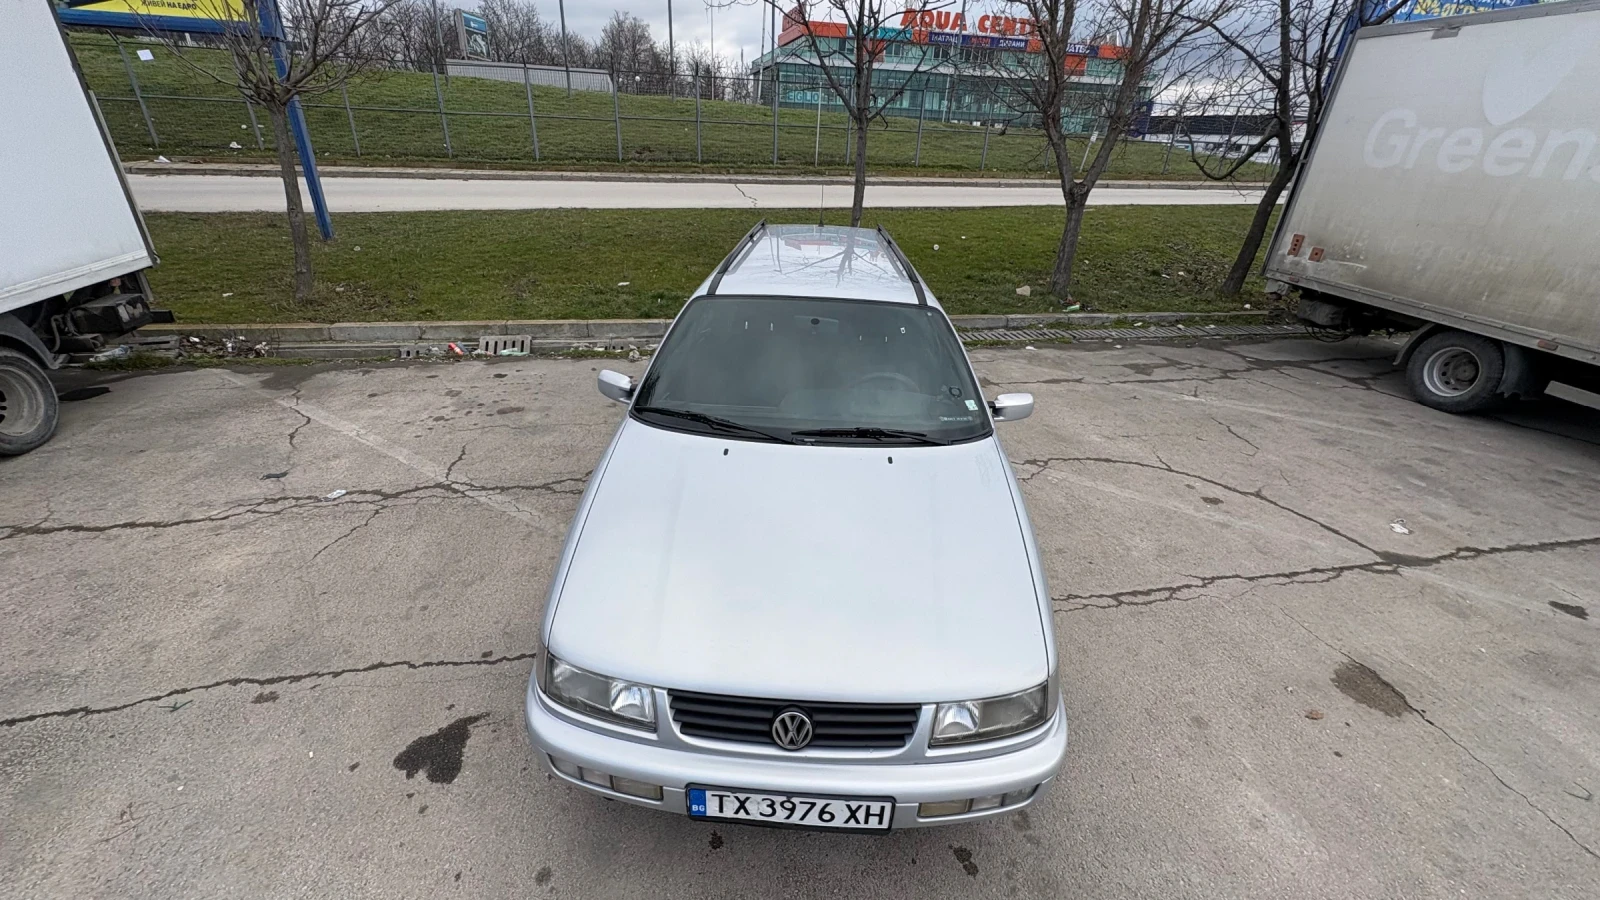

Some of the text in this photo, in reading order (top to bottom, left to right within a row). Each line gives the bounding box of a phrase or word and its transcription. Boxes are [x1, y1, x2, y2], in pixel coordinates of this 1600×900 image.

[901, 8, 967, 32] AQUA
[978, 14, 1047, 38] CENTE
[1363, 108, 1600, 182] Green
[692, 804, 706, 812] BG
[711, 794, 886, 826] TX 3976 XH
